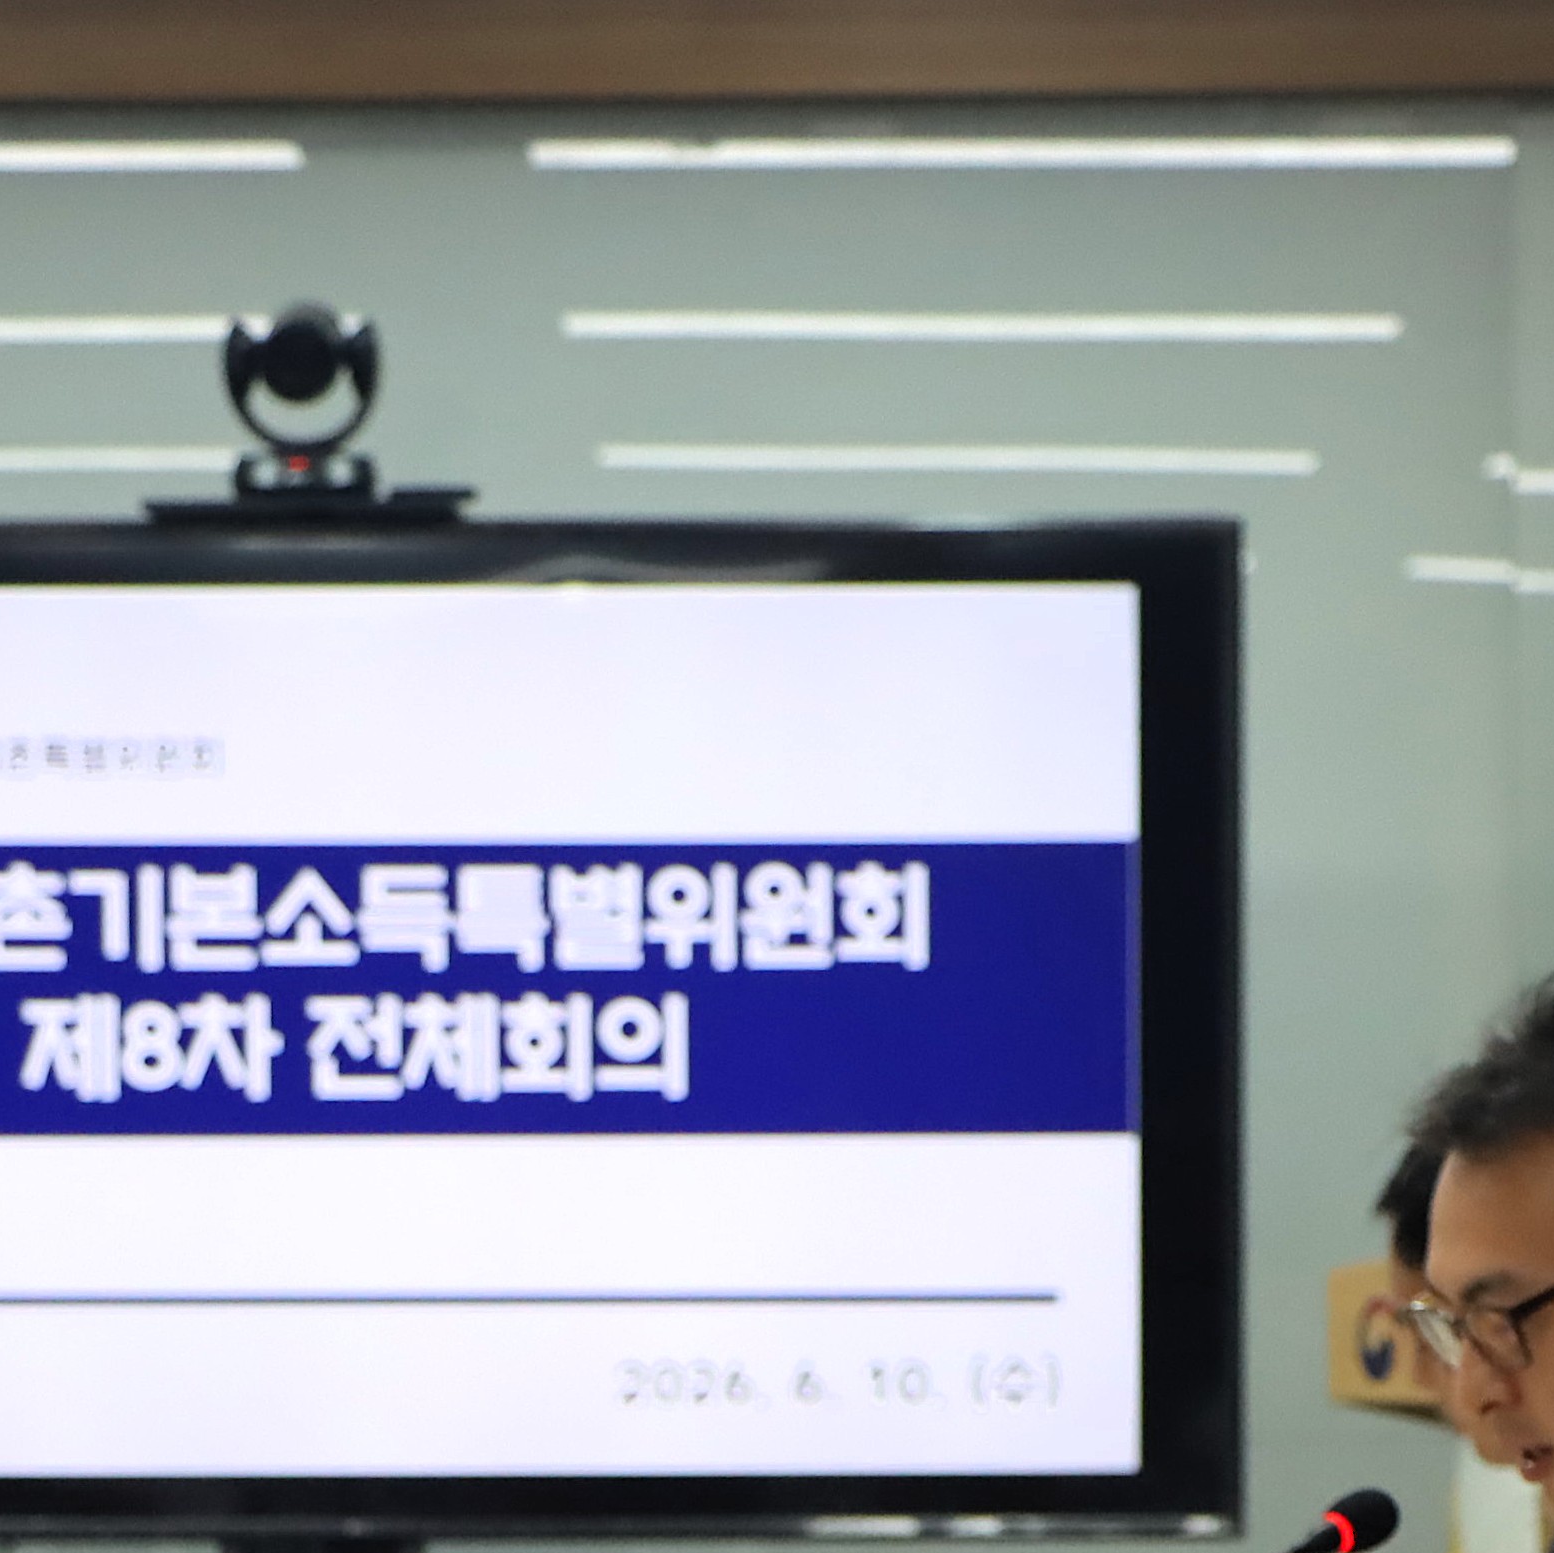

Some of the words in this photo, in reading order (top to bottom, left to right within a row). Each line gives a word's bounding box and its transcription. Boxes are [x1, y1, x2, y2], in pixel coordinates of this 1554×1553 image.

[20, 997, 281, 1099] 제8차
[305, 994, 689, 1101] 전체회의
[620, 1364, 767, 1408] 2026.
